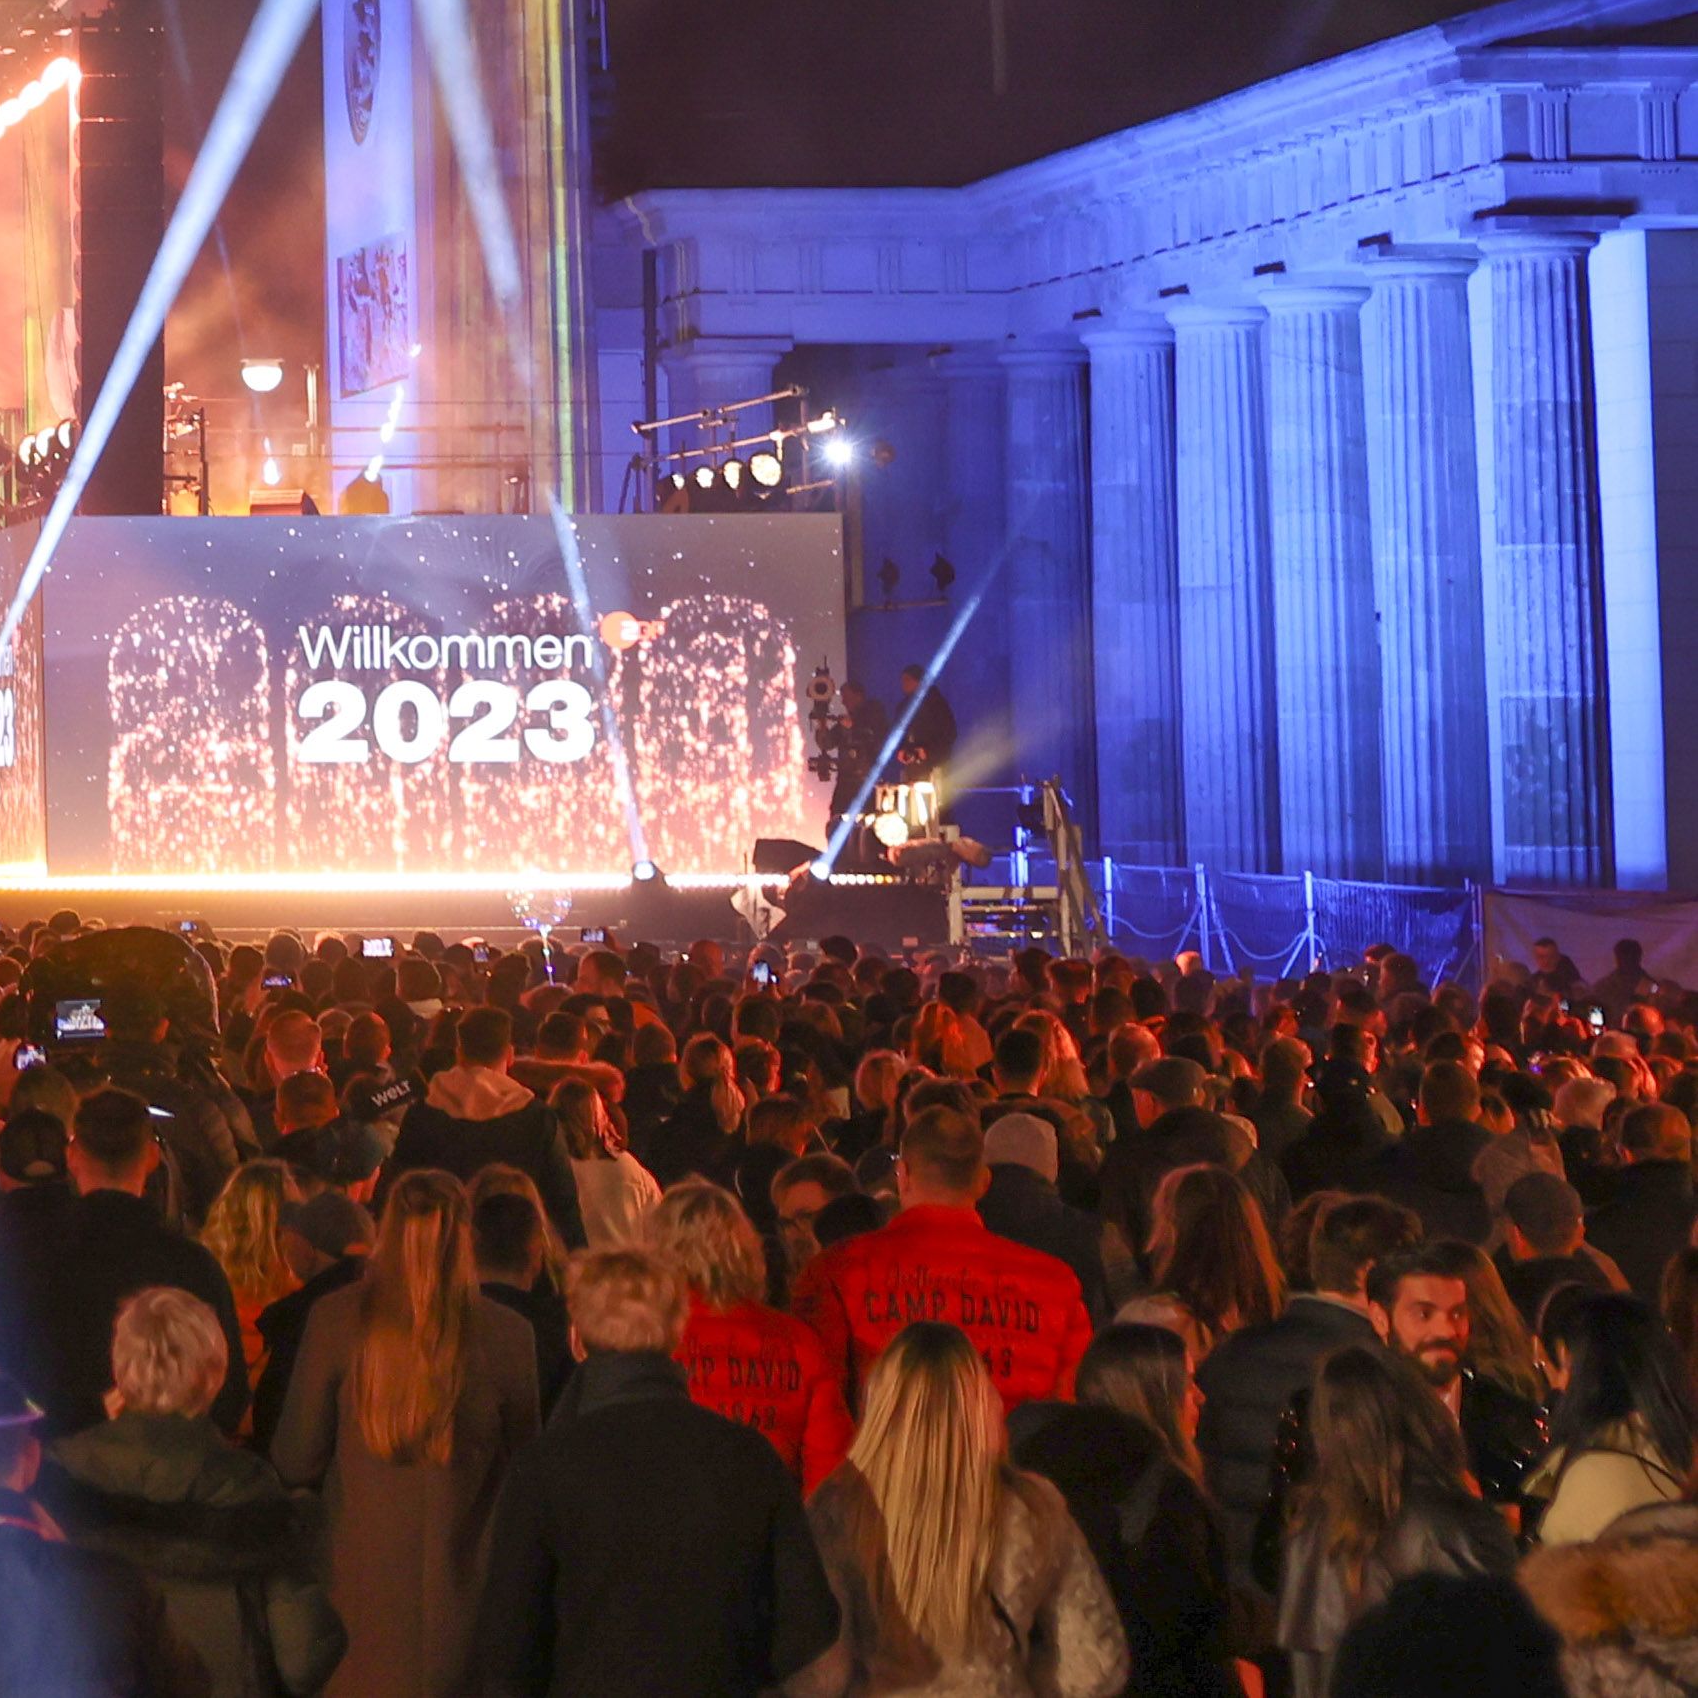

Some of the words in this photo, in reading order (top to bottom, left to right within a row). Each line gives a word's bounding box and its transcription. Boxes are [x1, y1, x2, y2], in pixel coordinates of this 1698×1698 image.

[298, 624, 592, 670] Willkommen
[297, 679, 596, 764] 2023
[960, 1293, 1041, 1333] DAVID
[727, 1356, 801, 1392] DAVID
